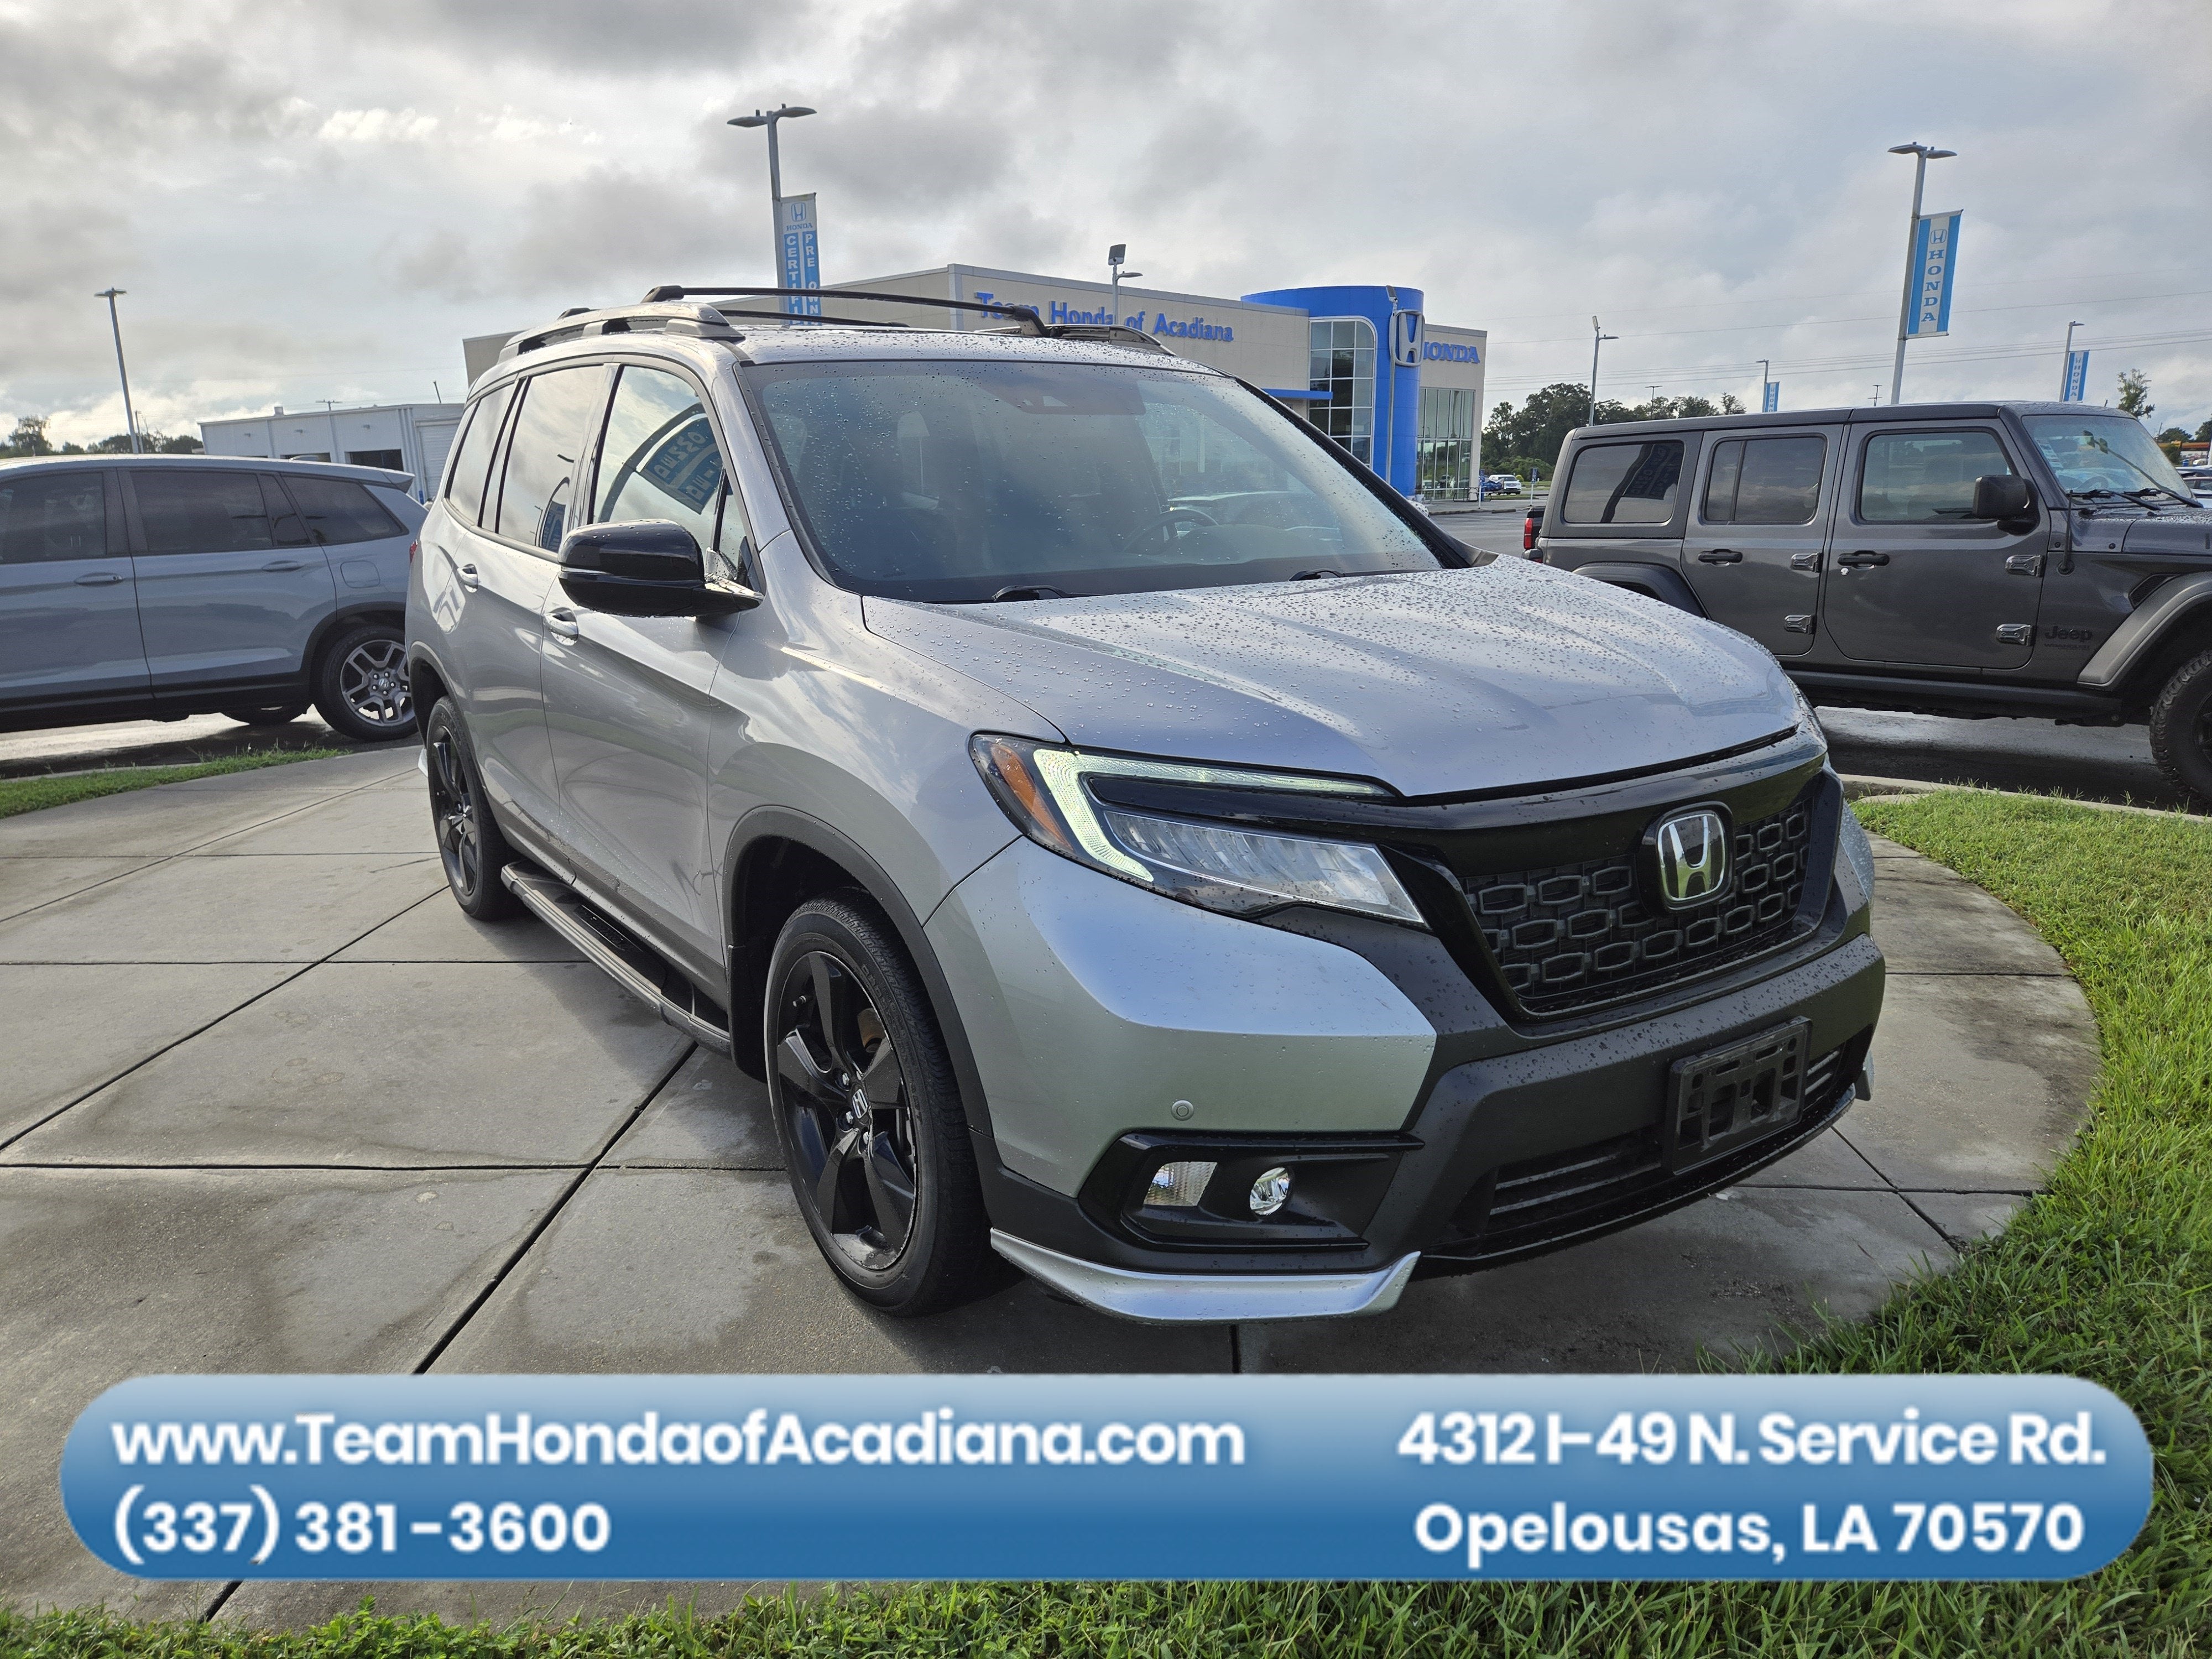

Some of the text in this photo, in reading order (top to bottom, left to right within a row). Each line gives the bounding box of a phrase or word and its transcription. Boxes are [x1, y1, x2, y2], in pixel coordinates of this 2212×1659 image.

[786, 222, 813, 231] HONDA
[786, 235, 800, 325] CERTIFI
[805, 233, 819, 325] PRE OWN
[1921, 249, 1945, 323] HONDA
[1049, 300, 1113, 325] Honda
[1124, 311, 1146, 331] of
[1152, 313, 1234, 342] Acadiana
[2044, 625, 2093, 643] Jeep
